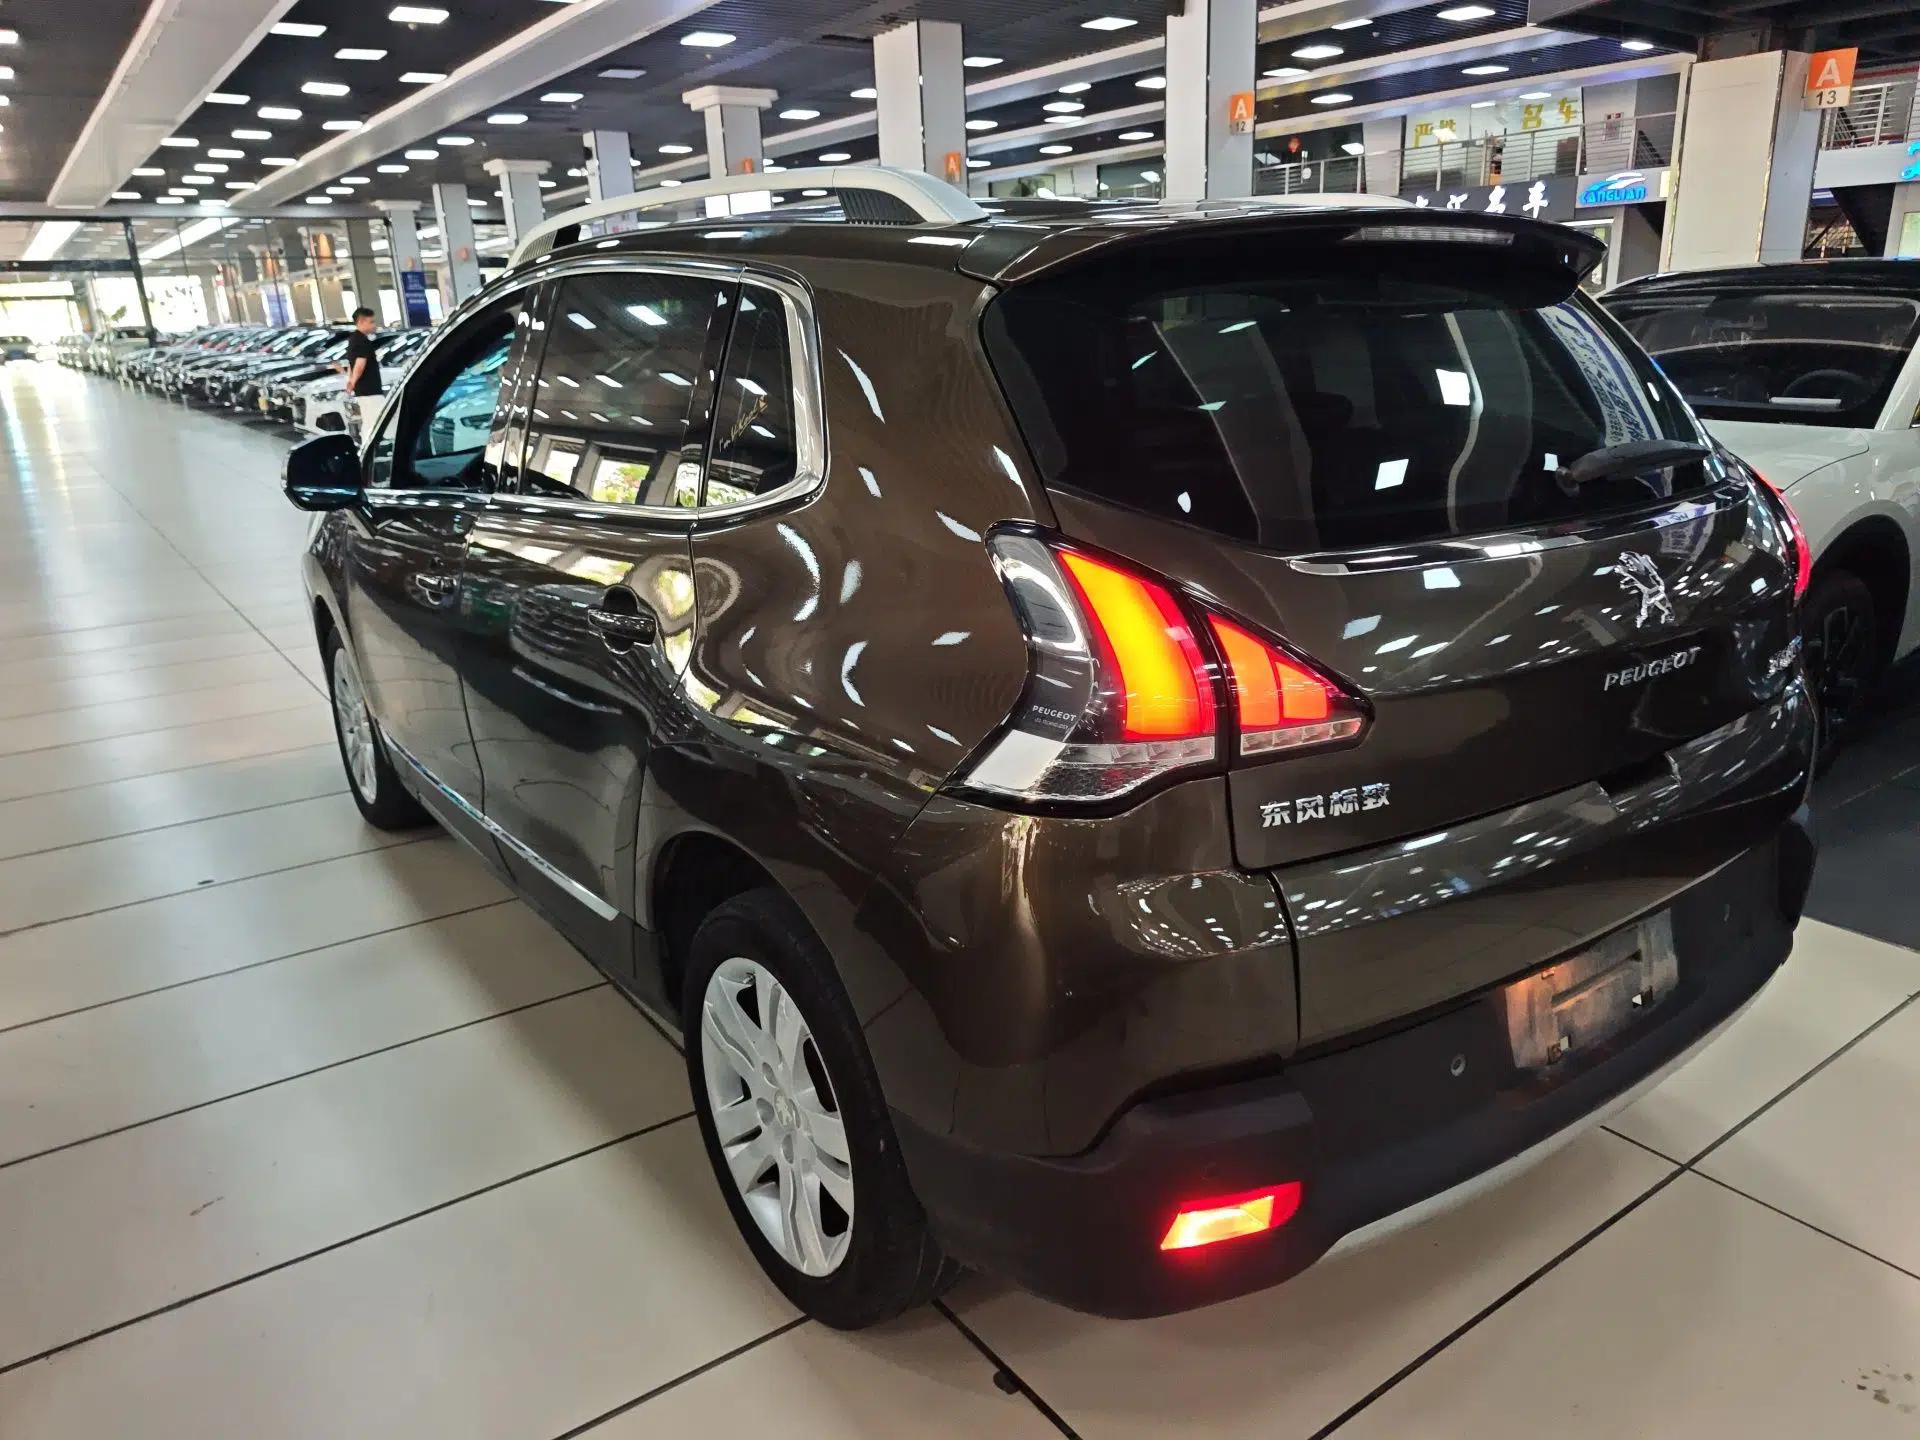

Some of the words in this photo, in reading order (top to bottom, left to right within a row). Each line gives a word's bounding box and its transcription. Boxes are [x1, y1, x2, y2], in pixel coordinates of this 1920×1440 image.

[1816, 58, 1842, 88] A
[1234, 98, 1247, 119] A
[1815, 90, 1837, 106] 13
[1235, 120, 1246, 131] 12
[1604, 646, 1701, 691] PEUGEOT
[1032, 705, 1077, 721] PEUGEOT
[1259, 782, 1390, 828] 东风标致
